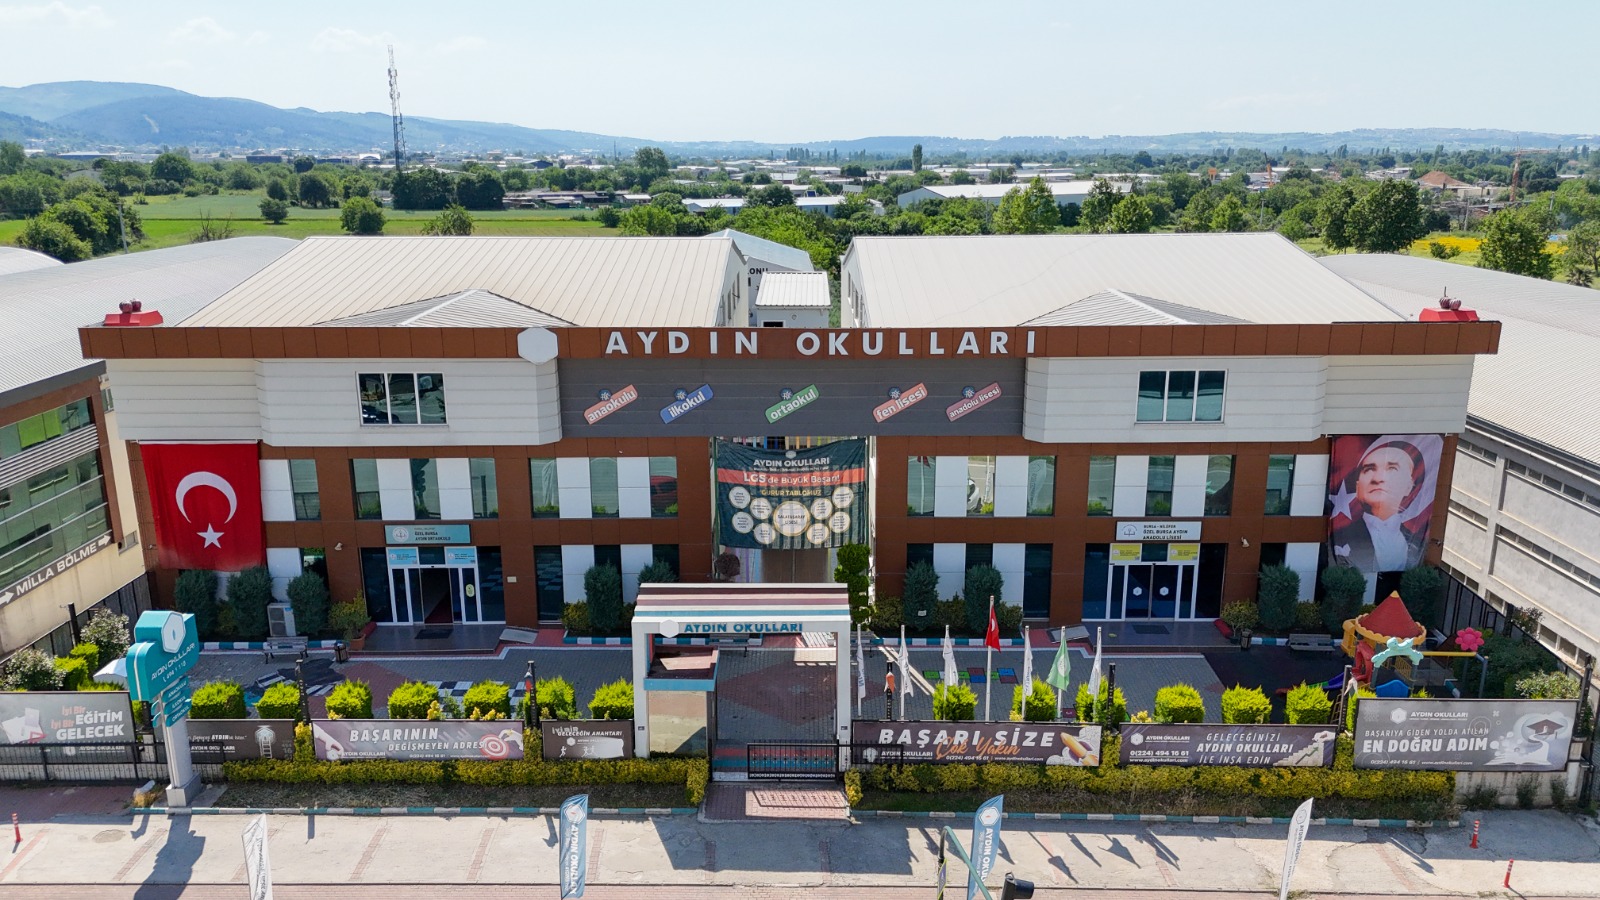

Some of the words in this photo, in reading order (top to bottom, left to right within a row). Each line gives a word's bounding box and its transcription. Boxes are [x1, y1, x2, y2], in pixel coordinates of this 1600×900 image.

[605, 330, 758, 355] AYDIN
[796, 330, 1035, 355] OKULLARI
[587, 390, 636, 421] anaokulu
[668, 391, 706, 418] ilkokul
[770, 388, 817, 420] ortaokul
[876, 403, 897, 420] fen
[896, 387, 926, 410] lisesi
[949, 398, 979, 418] anadolu
[978, 386, 1001, 403] lisesi
[753, 458, 783, 467] AYDIN
[784, 457, 829, 467] OKULLARI
[743, 472, 766, 483] LGS
[781, 477, 808, 485] Büyük
[16, 567, 54, 596] MİLLA
[56, 543, 97, 573] BÖLME
[683, 623, 727, 633] AYDIN
[733, 623, 803, 633] OKULLARI
[75, 709, 123, 725] EĞİTİM
[56, 724, 124, 740] GELECEK
[350, 727, 439, 744] BAŞARININ
[878, 729, 981, 749] BAŞARI
[993, 726, 1055, 747] SİZE
[1206, 732, 1280, 742] GELECEĞİNİZİ
[1433, 728, 1458, 736] YOLDA
[388, 742, 449, 751] DEĞİŞMEYEN
[936, 736, 969, 760] Çok
[975, 736, 1020, 758] Yakın
[1196, 743, 1233, 753] AYDIN
[1235, 743, 1293, 753] OKULLARI
[1362, 739, 1384, 753] EN
[1388, 736, 1442, 753] DOĞRU
[1446, 737, 1488, 751] ADIM
[1199, 755, 1215, 764] İLE
[1218, 755, 1242, 765] İNŞA
[1246, 755, 1270, 764] EDİN
[571, 825, 579, 853] AYDIN
[983, 827, 994, 855] AYDIN
